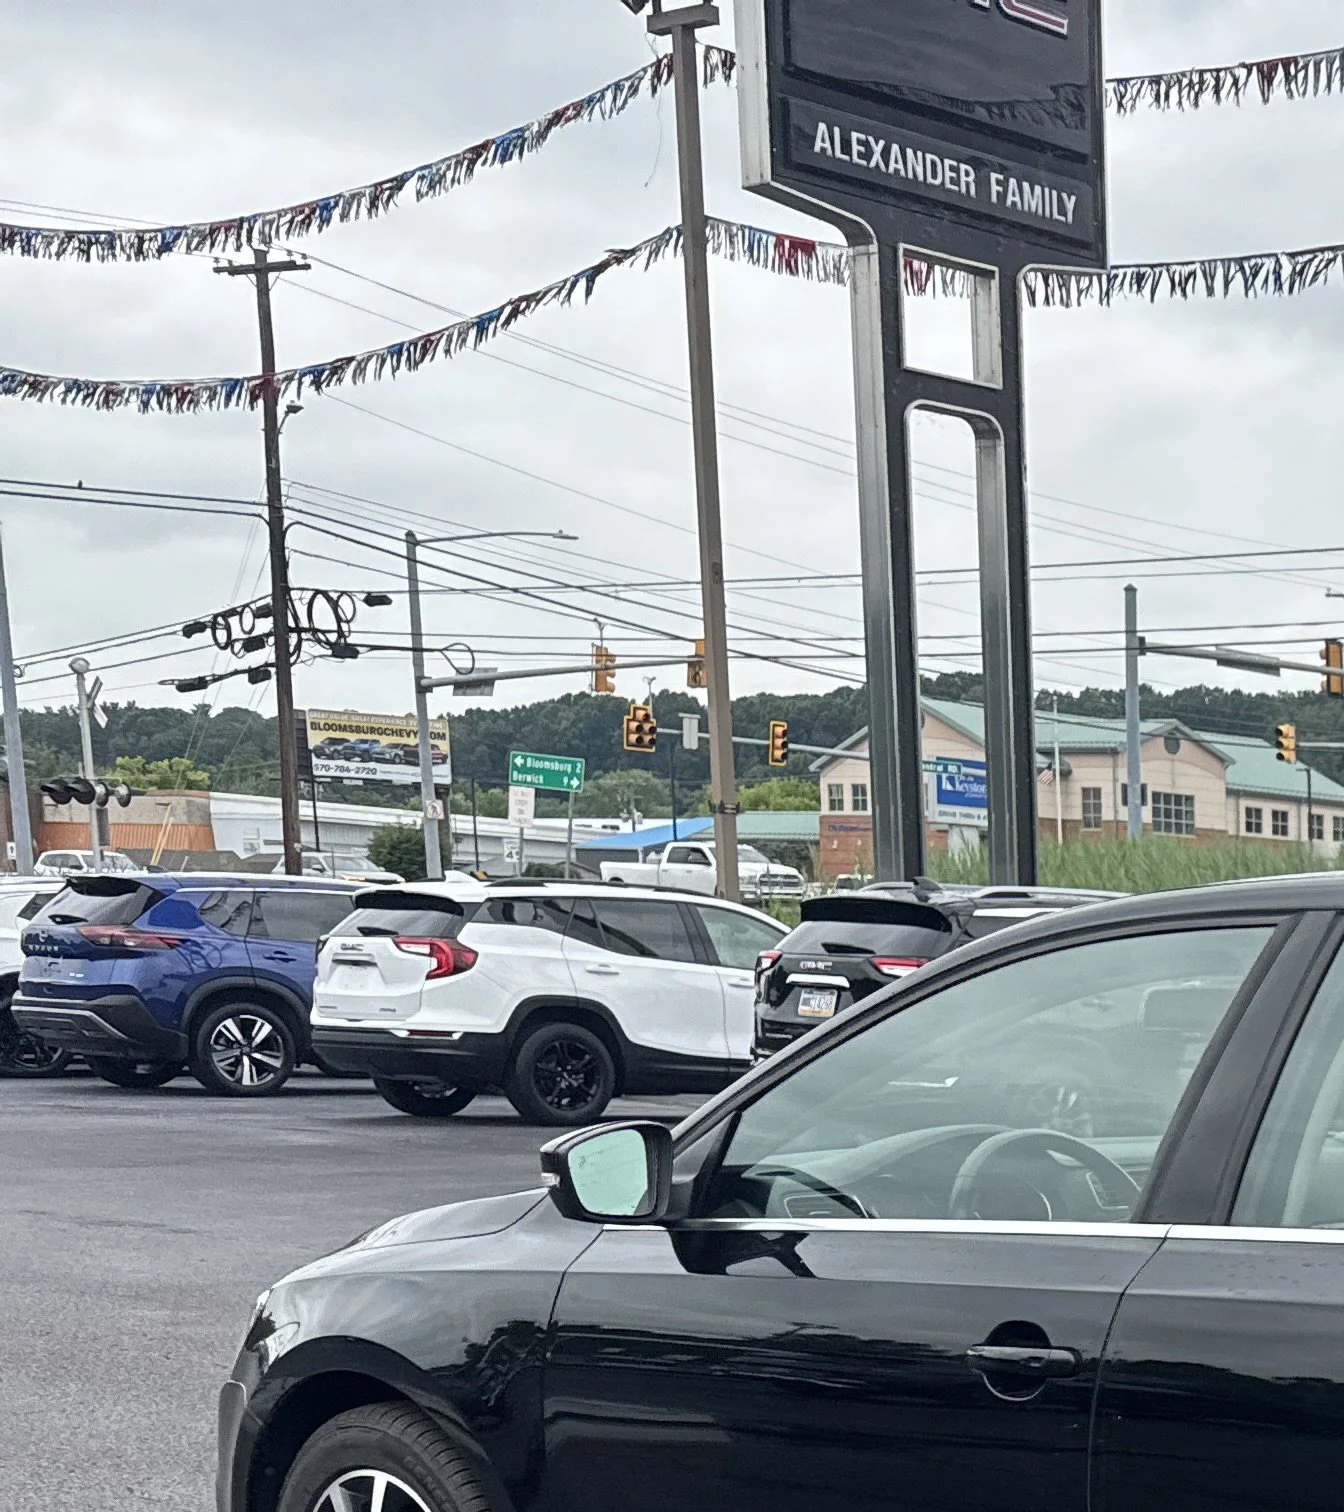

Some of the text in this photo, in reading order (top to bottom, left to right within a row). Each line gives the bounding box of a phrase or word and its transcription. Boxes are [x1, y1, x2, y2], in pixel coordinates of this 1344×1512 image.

[813, 121, 1077, 225] ALEXANDER FAMILY
[310, 721, 447, 742] BLOOMSBURGCHEVYOM
[313, 763, 378, 776] 570-784-2720
[526, 757, 582, 774] Bloomsburg 2
[512, 770, 569, 786] Berwick 9
